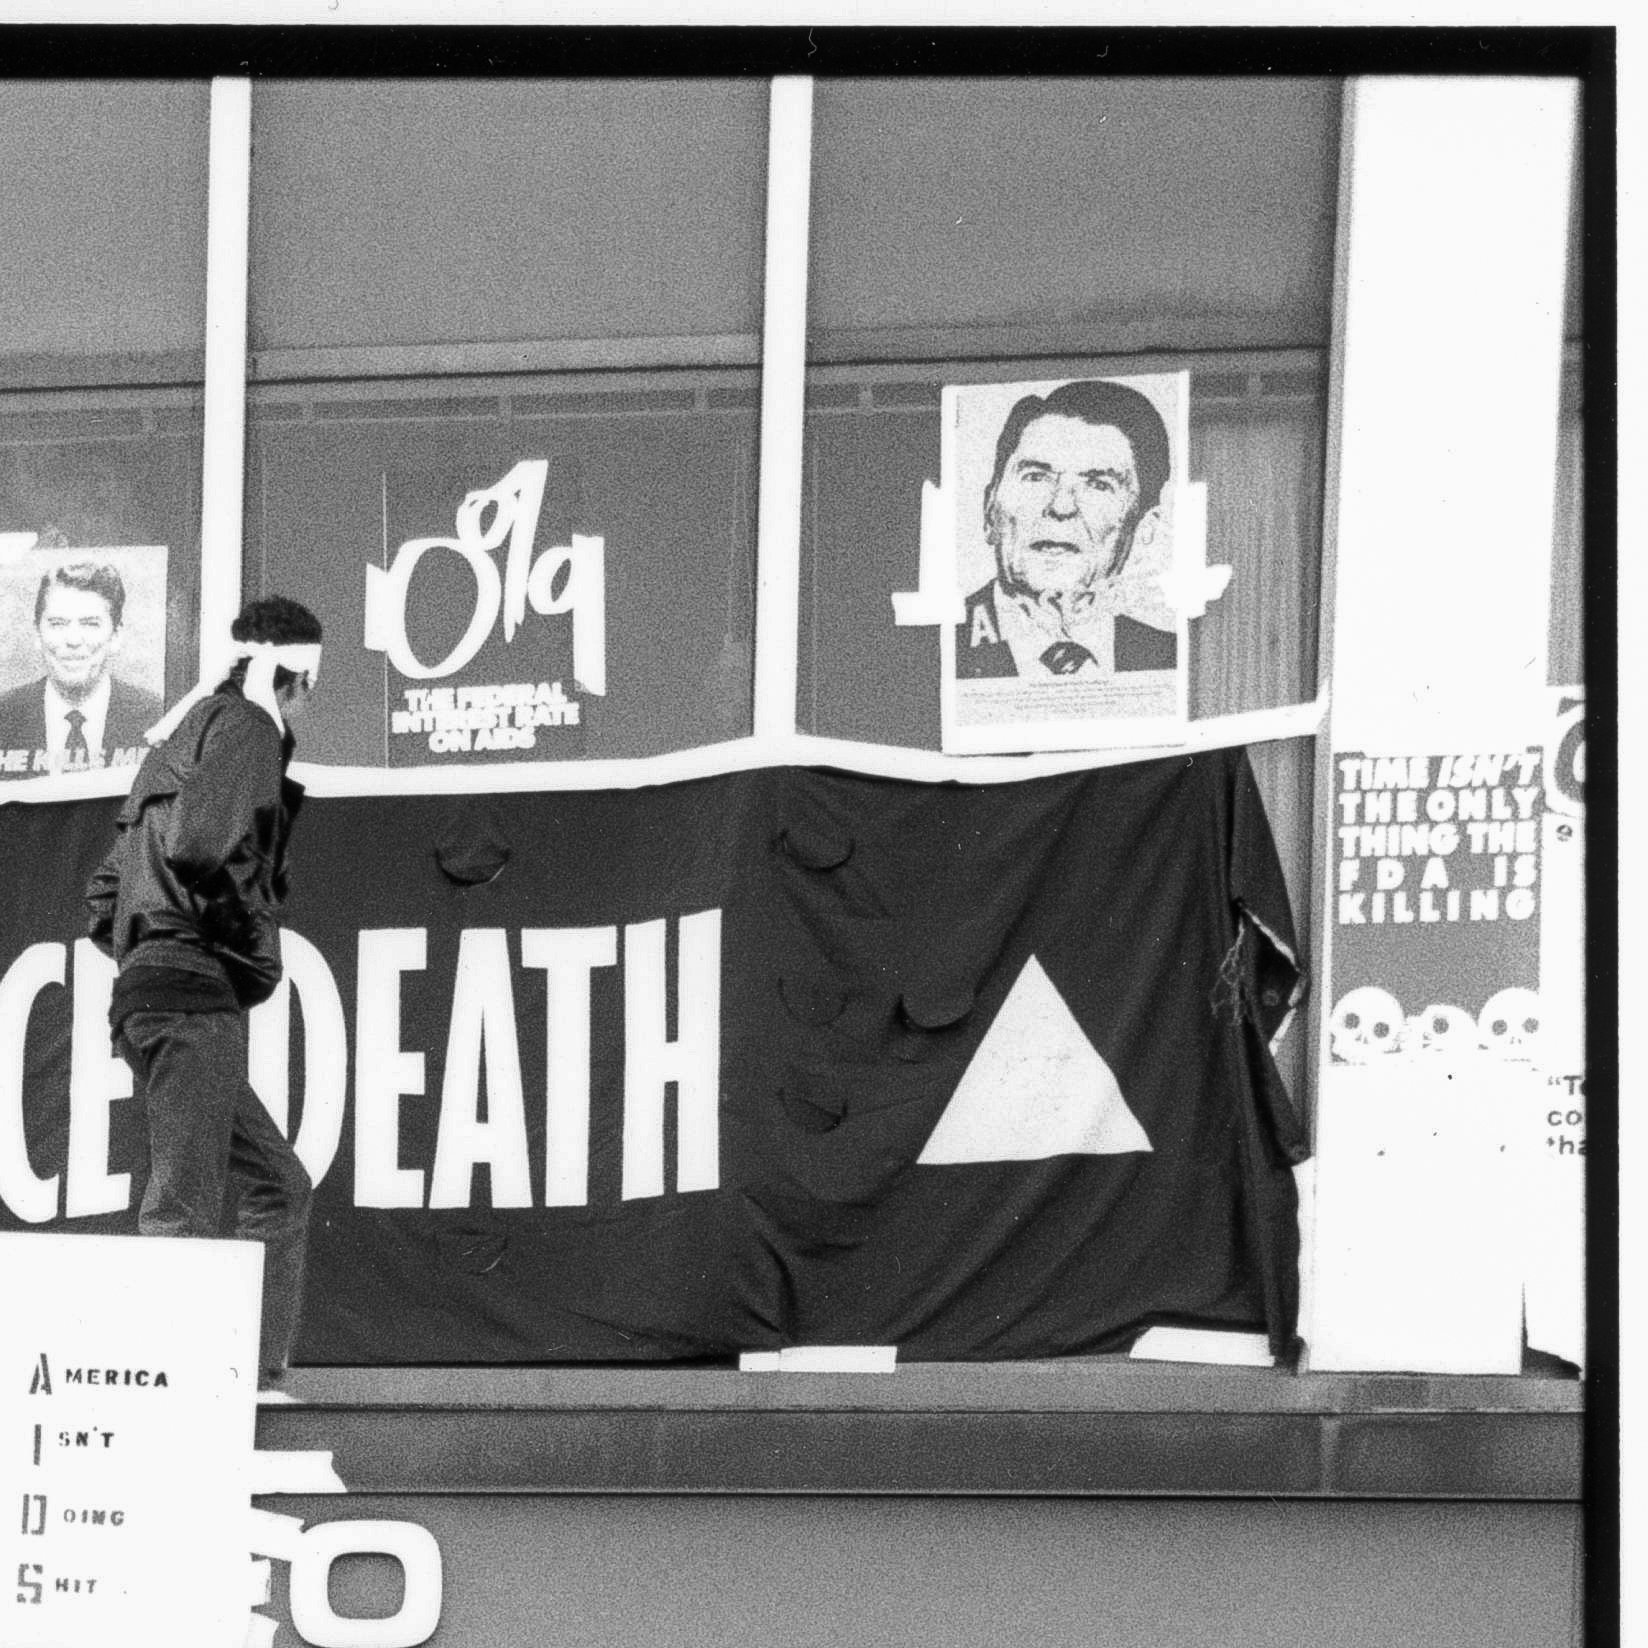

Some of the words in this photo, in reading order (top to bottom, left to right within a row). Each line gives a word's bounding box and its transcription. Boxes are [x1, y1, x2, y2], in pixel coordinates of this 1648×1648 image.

[404, 688, 455, 711] THE
[456, 682, 568, 709] FEDERAL
[514, 702, 580, 727] RATE
[429, 729, 471, 753] ON
[474, 726, 536, 751] AIDS
[1339, 757, 1430, 790] TIME
[1436, 755, 1541, 788] ISN'T
[1339, 790, 1417, 824] THE
[1426, 786, 1539, 822] ONLY
[1338, 823, 1460, 857] THING
[1466, 820, 1536, 854] THE
[1493, 854, 1537, 888] IS
[1338, 888, 1536, 925] KILLING
[248, 909, 723, 1210] DEATH
[29, 1353, 169, 1395] AMERICA
[21, 1494, 125, 1535] DOING
[16, 1563, 97, 1604] SHIT
